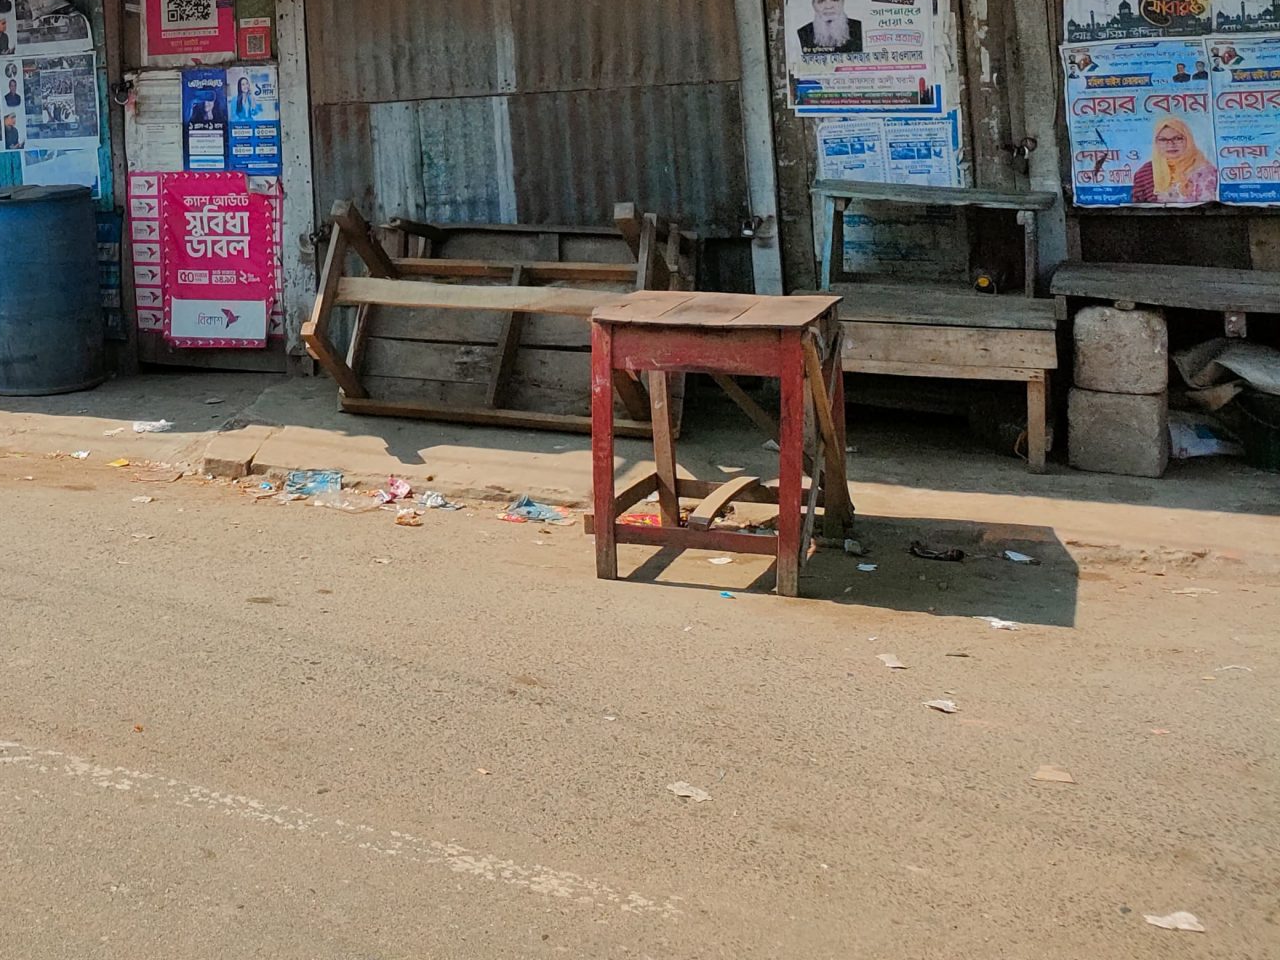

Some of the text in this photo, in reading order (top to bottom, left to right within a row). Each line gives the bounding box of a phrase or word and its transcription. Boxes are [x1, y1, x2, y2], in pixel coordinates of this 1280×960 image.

[870, 7, 921, 16] আপনাদের
[1072, 93, 1209, 116] নেহার বেগম
[1075, 149, 1140, 163] দোয়া ও
[1219, 145, 1272, 159] দোয়া
[1077, 168, 1105, 184] ভোট
[1221, 162, 1253, 180] ভোট
[183, 193, 249, 208] ক্যাশ আউটে
[184, 205, 250, 236] সুবিধা
[184, 236, 250, 259] ডাবল
[198, 313, 223, 326] বিকাশ
